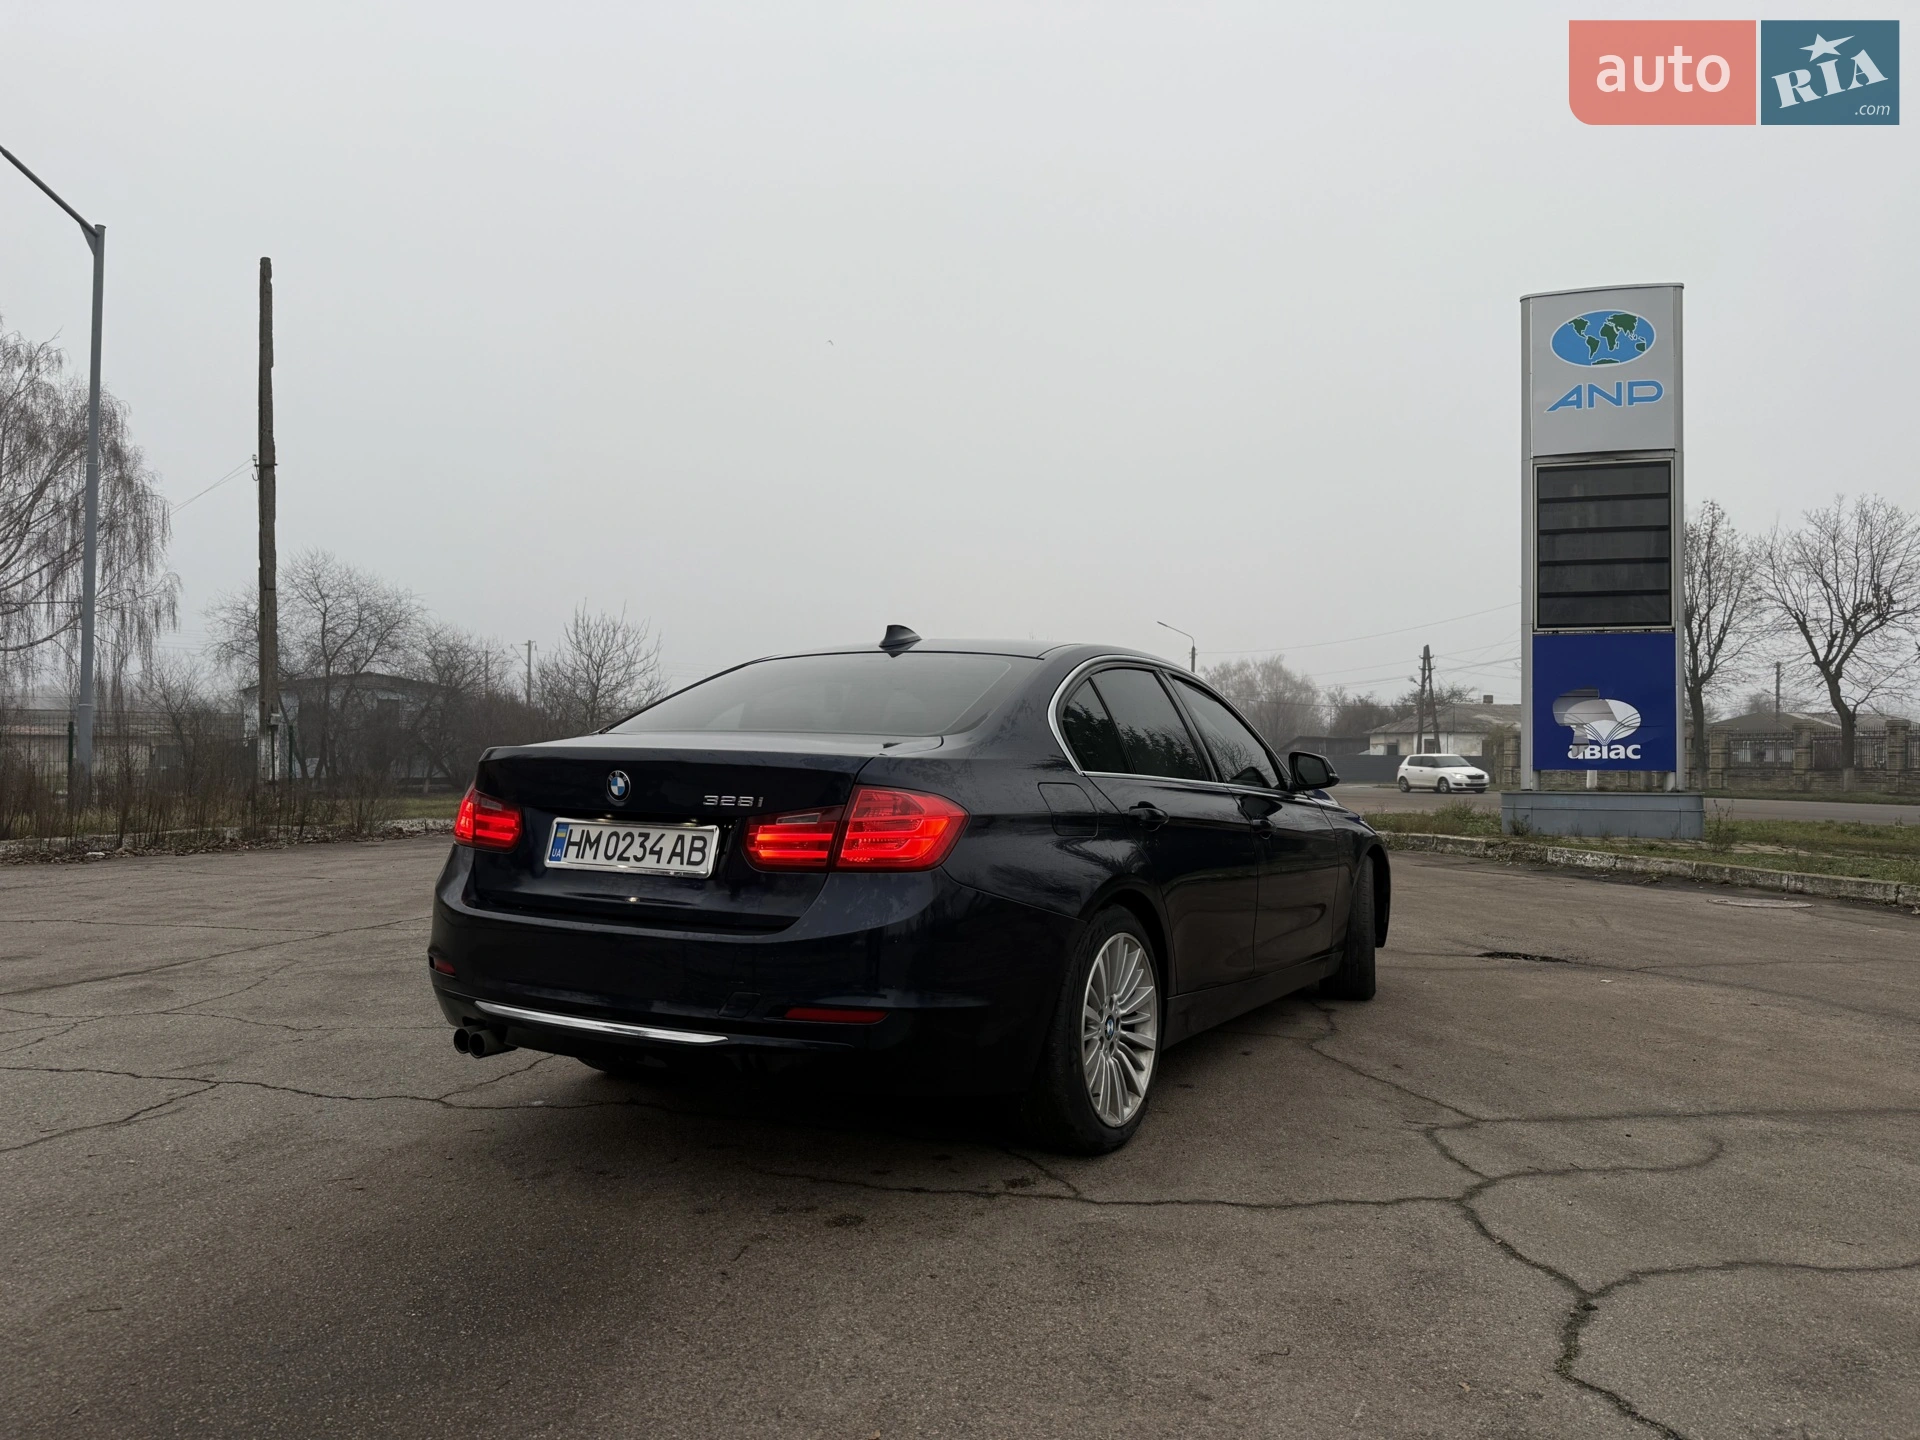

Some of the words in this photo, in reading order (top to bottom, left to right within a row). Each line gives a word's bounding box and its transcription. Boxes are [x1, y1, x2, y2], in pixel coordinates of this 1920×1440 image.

[1544, 379, 1663, 413] ANP
[703, 795, 764, 808] 328i
[551, 850, 562, 858] UA
